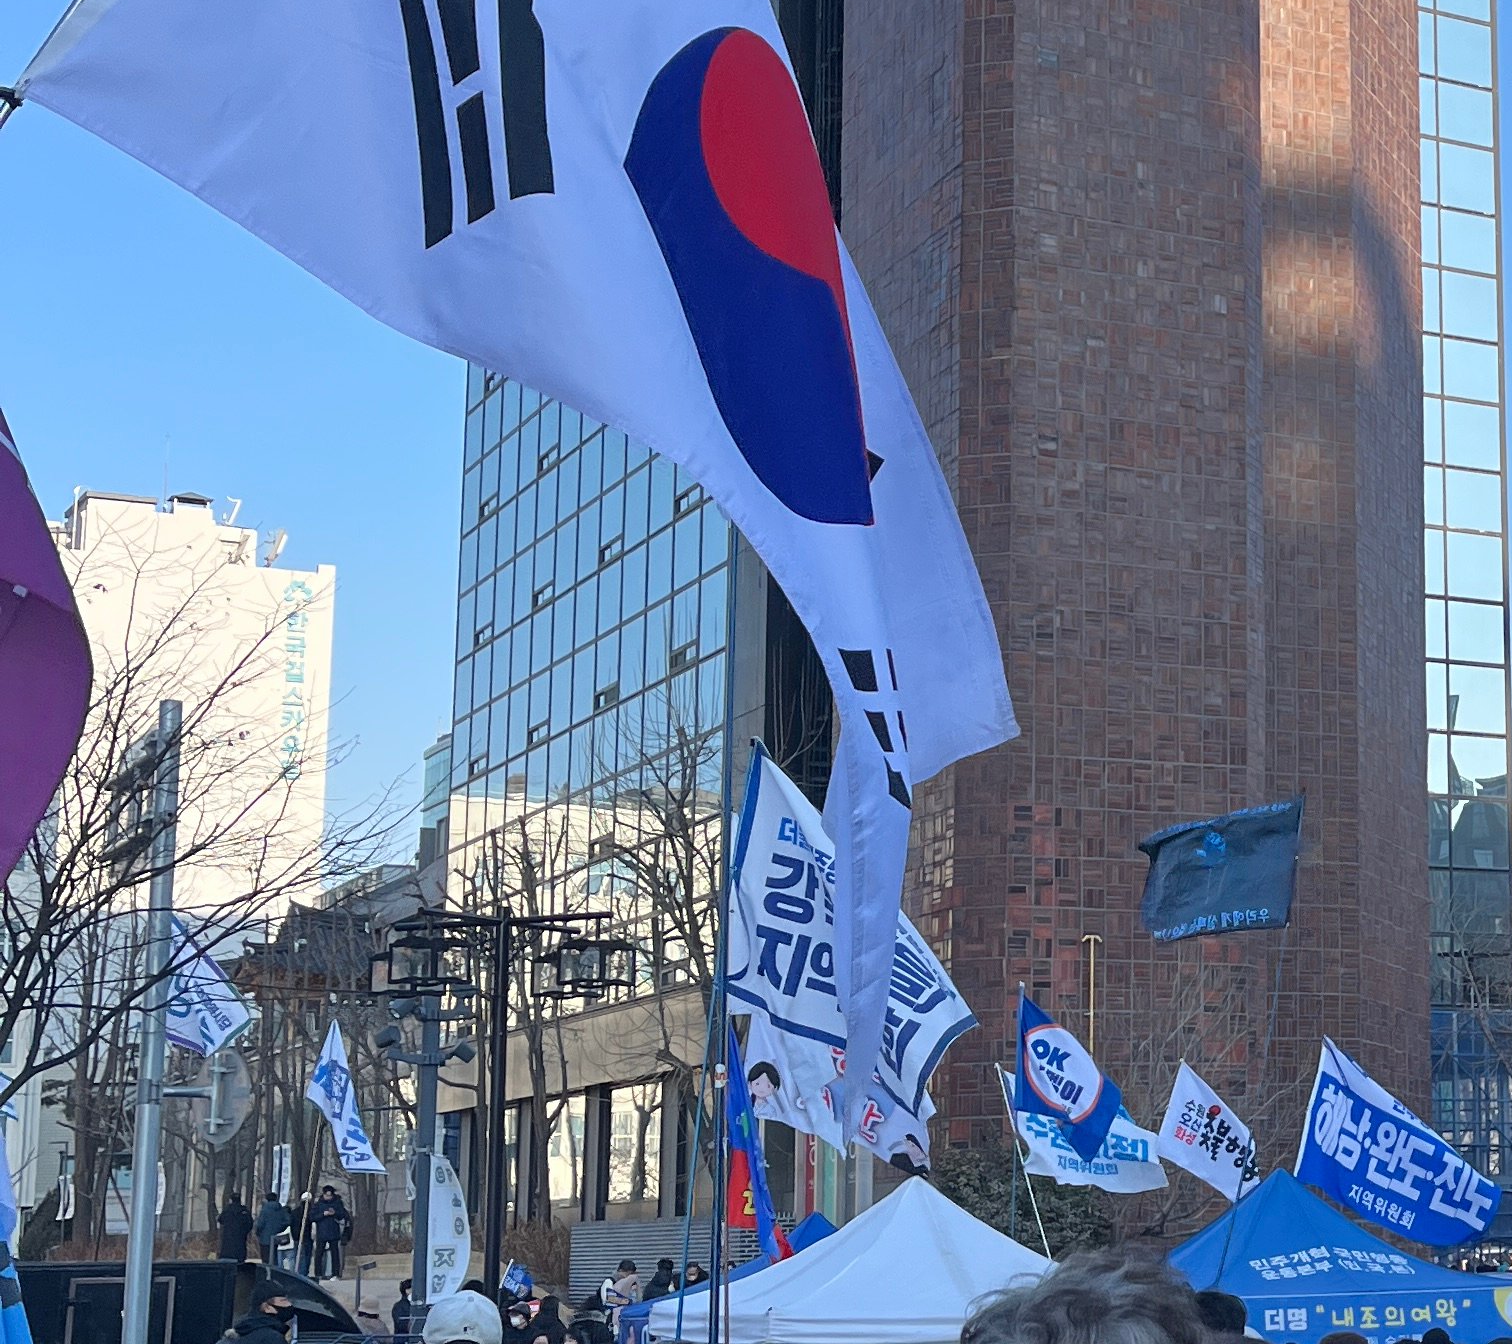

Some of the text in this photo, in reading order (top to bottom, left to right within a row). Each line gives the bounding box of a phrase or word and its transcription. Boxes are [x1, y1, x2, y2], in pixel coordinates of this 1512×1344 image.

[1030, 1038, 1072, 1073] OK
[1183, 1098, 1206, 1120] 수원
[1179, 1113, 1201, 1134] 오산
[1174, 1125, 1198, 1146] 화성
[1057, 1154, 1119, 1176] 지역위원회
[1348, 1183, 1417, 1231] 지역위원회
[1248, 1245, 1331, 1271] 민주개혁
[1261, 1260, 1333, 1281] 운동본부
[1264, 1307, 1308, 1332] 더명
